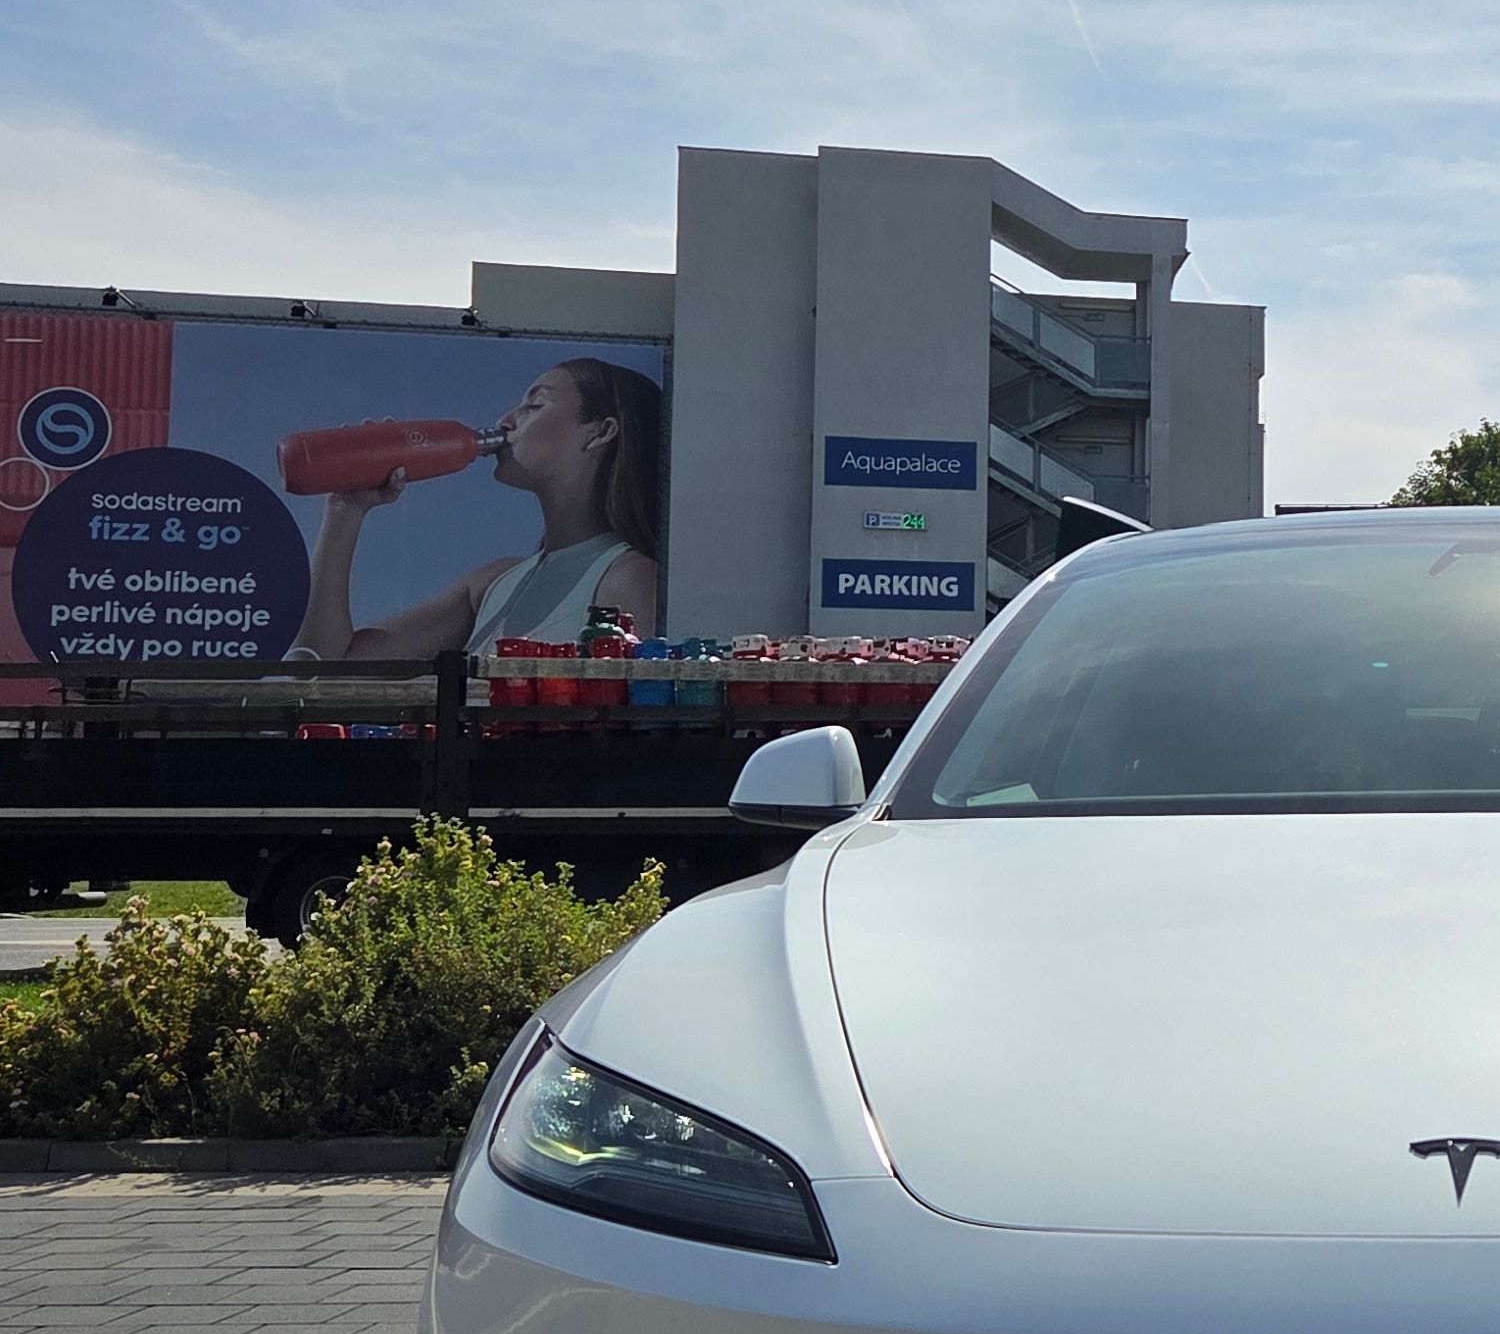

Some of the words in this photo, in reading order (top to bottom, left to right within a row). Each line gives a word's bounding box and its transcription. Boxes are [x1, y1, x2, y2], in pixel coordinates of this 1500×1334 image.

[841, 450, 961, 475] Aquapalace
[91, 492, 242, 513] sodastream
[88, 515, 150, 541] fizz
[161, 517, 186, 542] &
[197, 525, 242, 550] go
[68, 567, 116, 590] tvé
[124, 570, 257, 594] oblíbené
[838, 573, 958, 597] PARKING
[51, 601, 156, 626] perlivé
[165, 603, 270, 632] nápoje
[60, 633, 135, 661] vždy
[142, 639, 183, 661] po
[192, 640, 258, 657] ruce
